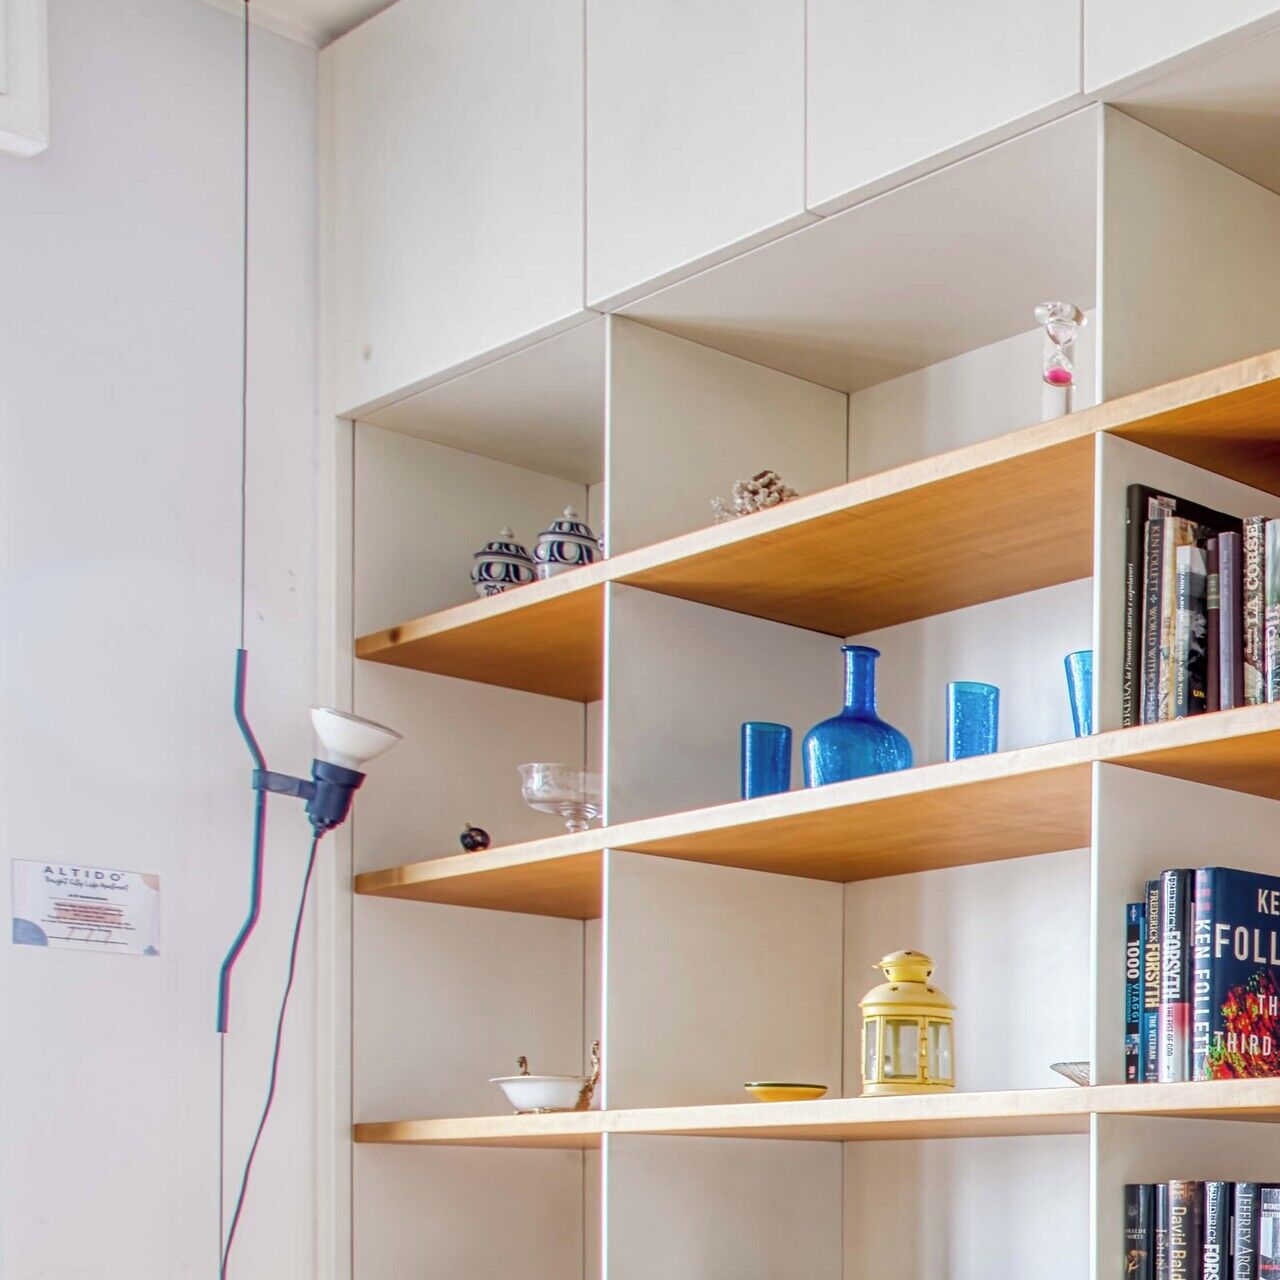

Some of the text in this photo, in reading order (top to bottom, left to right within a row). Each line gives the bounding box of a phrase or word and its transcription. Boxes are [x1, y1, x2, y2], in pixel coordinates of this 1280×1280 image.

[1151, 525, 1160, 547] KEN
[1150, 549, 1160, 594] FOLLETT
[1246, 525, 1259, 591] CORSE
[1148, 606, 1157, 646] WORLD
[44, 866, 121, 881] ALTIDO
[1127, 940, 1140, 979] 1000
[1145, 890, 1160, 1009] FREDERICK FORSYTH
[1132, 983, 1140, 1023] VIAGGI
[1194, 919, 1211, 1057] KEN FOLLETT
[1149, 1014, 1157, 1060] THE VETERAN
[1213, 1030, 1272, 1057] THIRD
[1171, 1206, 1187, 1246] David
[1237, 1193, 1253, 1243] JEFFREY
